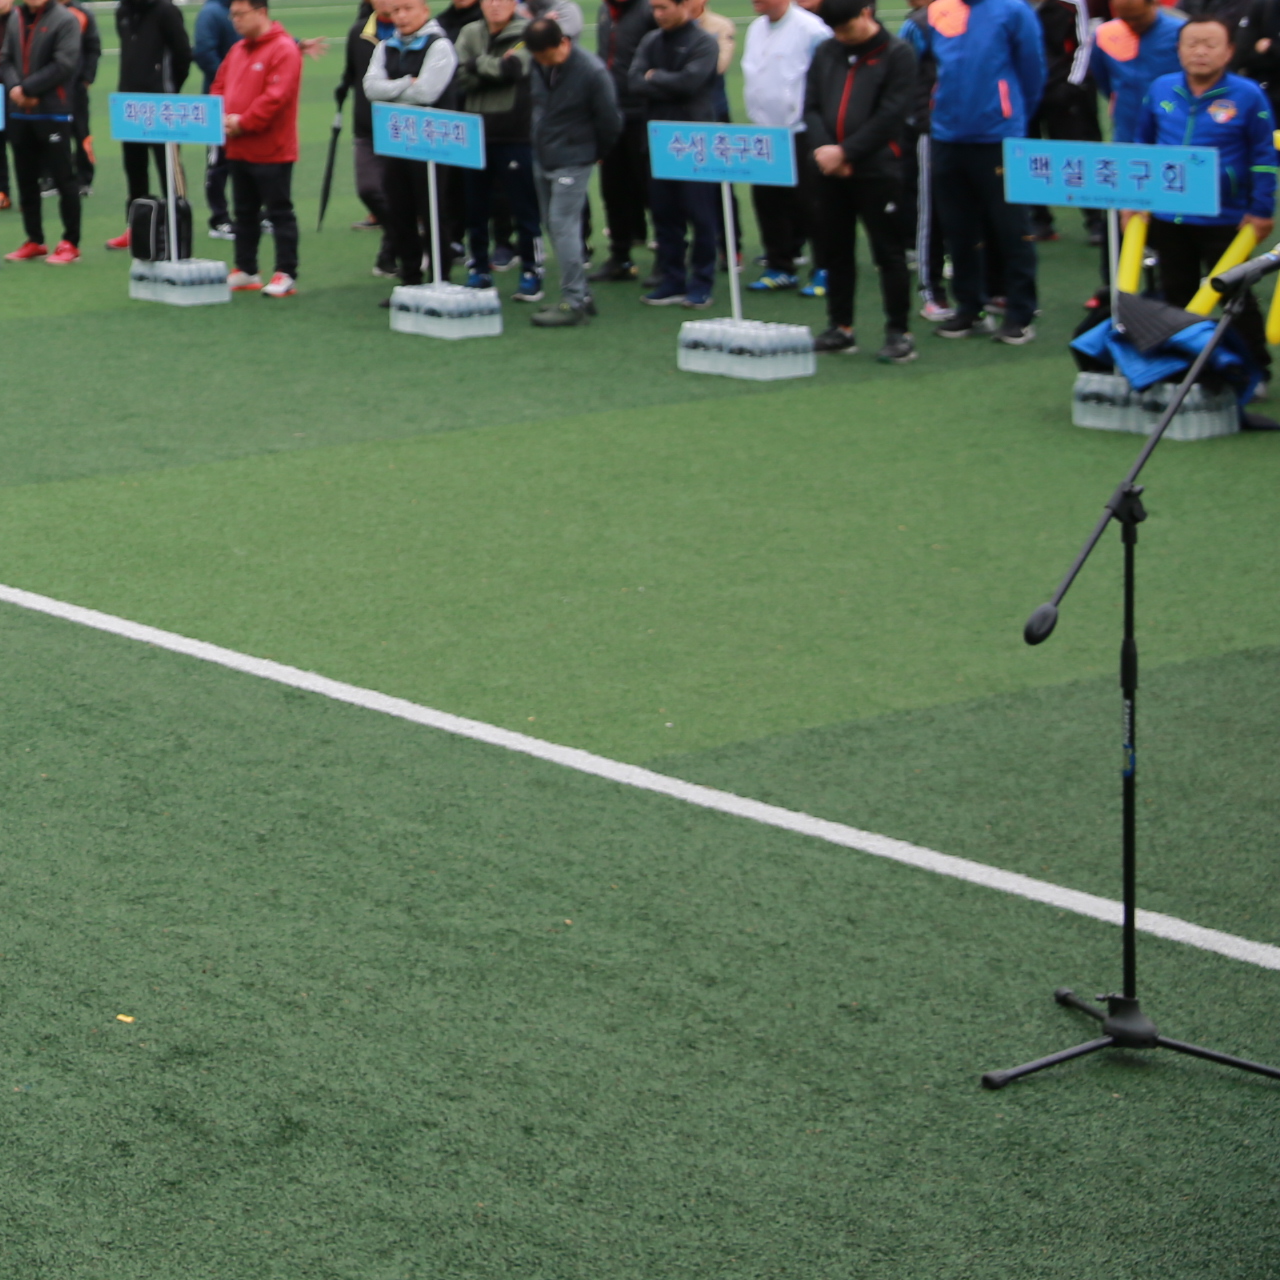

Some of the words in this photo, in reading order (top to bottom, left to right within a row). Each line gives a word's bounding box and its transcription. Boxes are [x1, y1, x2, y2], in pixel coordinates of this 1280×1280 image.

[160, 102, 207, 128] 축구회
[423, 117, 468, 148] 축구회
[712, 134, 773, 165] 축구회
